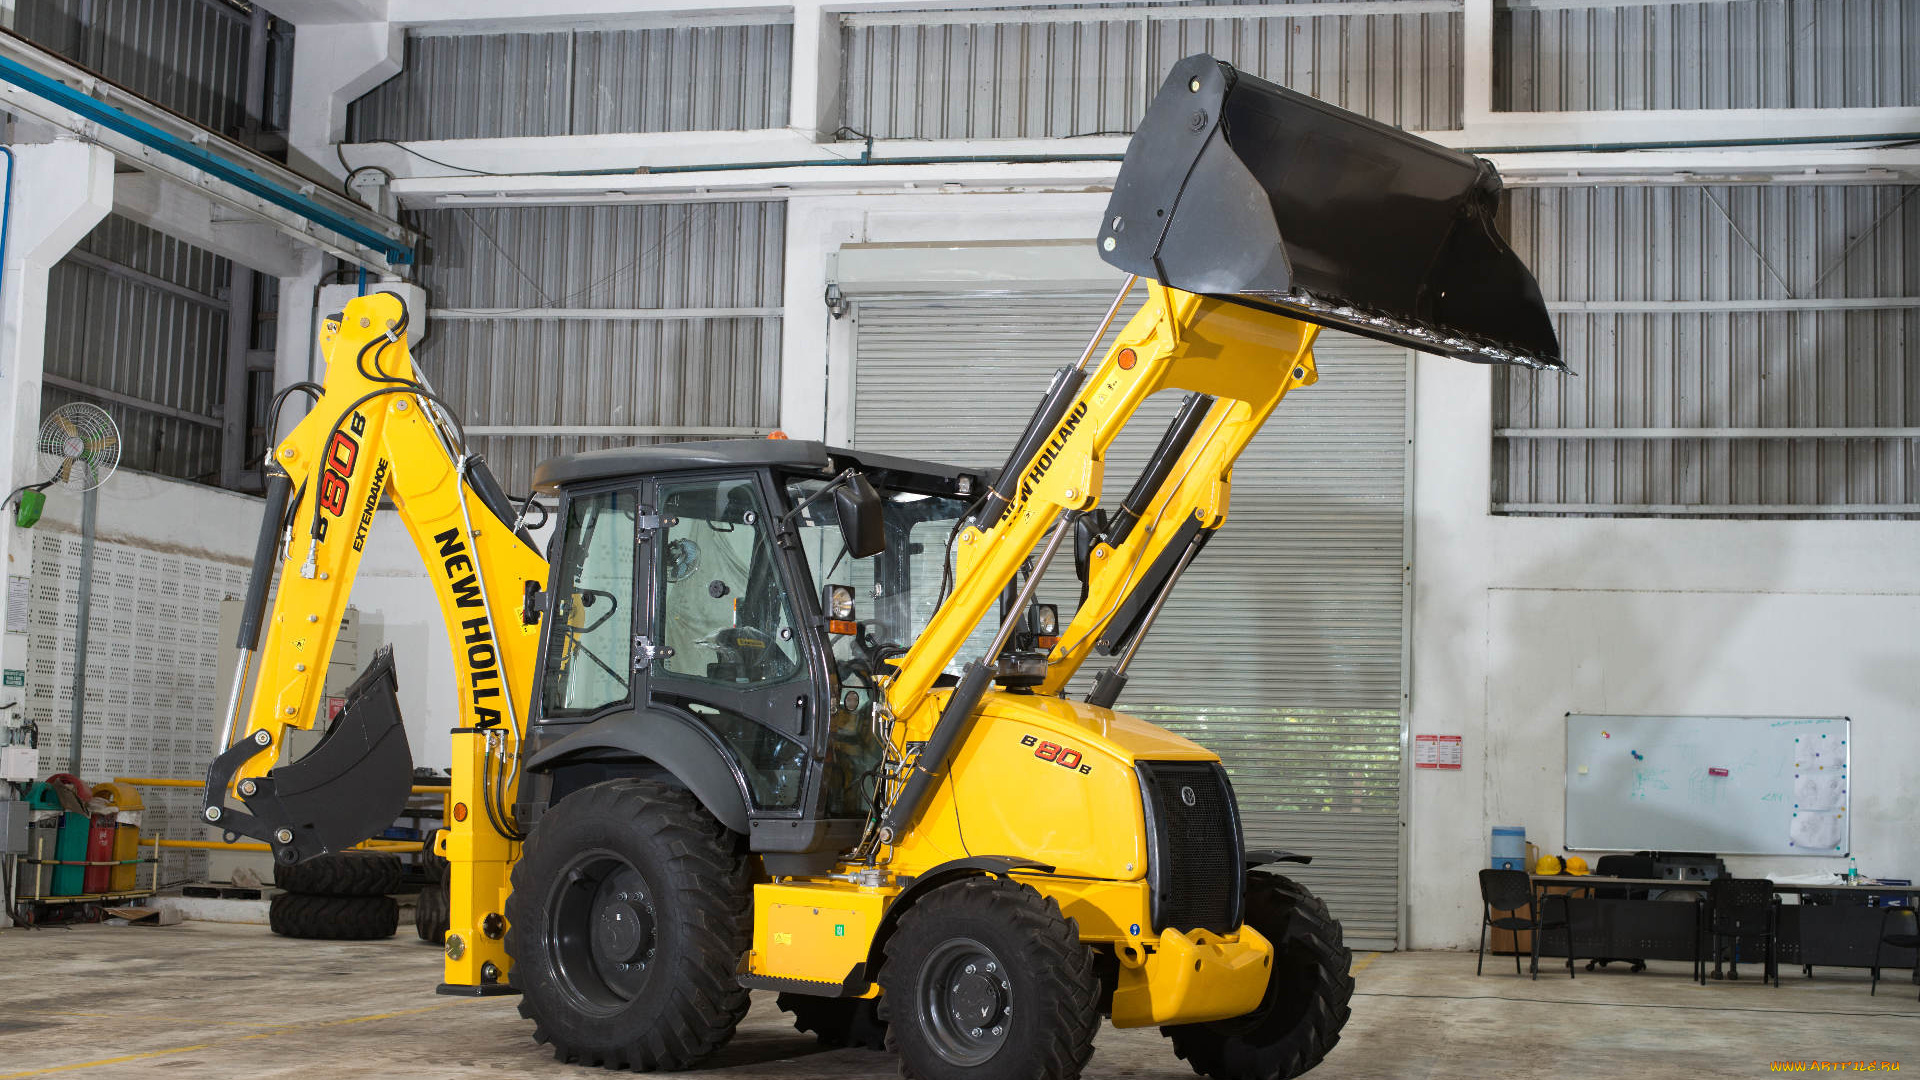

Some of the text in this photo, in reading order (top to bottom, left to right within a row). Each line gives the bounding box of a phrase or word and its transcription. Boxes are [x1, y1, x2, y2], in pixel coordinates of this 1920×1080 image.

[353, 457, 388, 553] EXTENDAHOE
[1001, 401, 1088, 526] NW HOLLAND
[434, 527, 502, 728] NEW HOLLA
